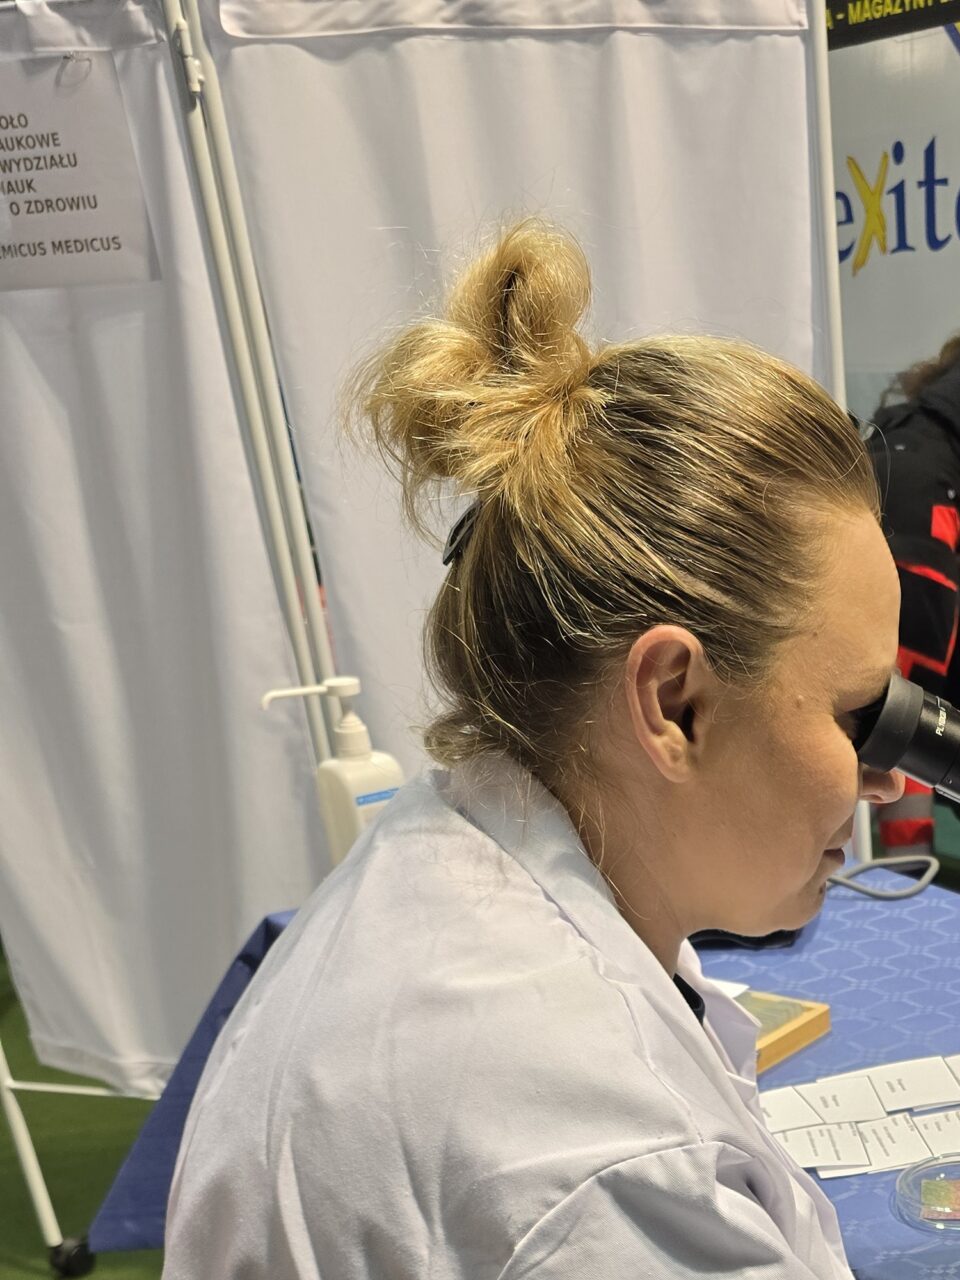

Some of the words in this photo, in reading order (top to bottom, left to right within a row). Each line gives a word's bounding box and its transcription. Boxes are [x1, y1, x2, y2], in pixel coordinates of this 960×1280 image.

[848, 0, 933, 25] MAGAZY
[0, 153, 78, 173] WYDZIAŁU
[10, 201, 20, 216] O
[25, 195, 98, 215] ZDROWIU
[0, 242, 47, 260] MICUS
[51, 236, 122, 255] MEDICUS
